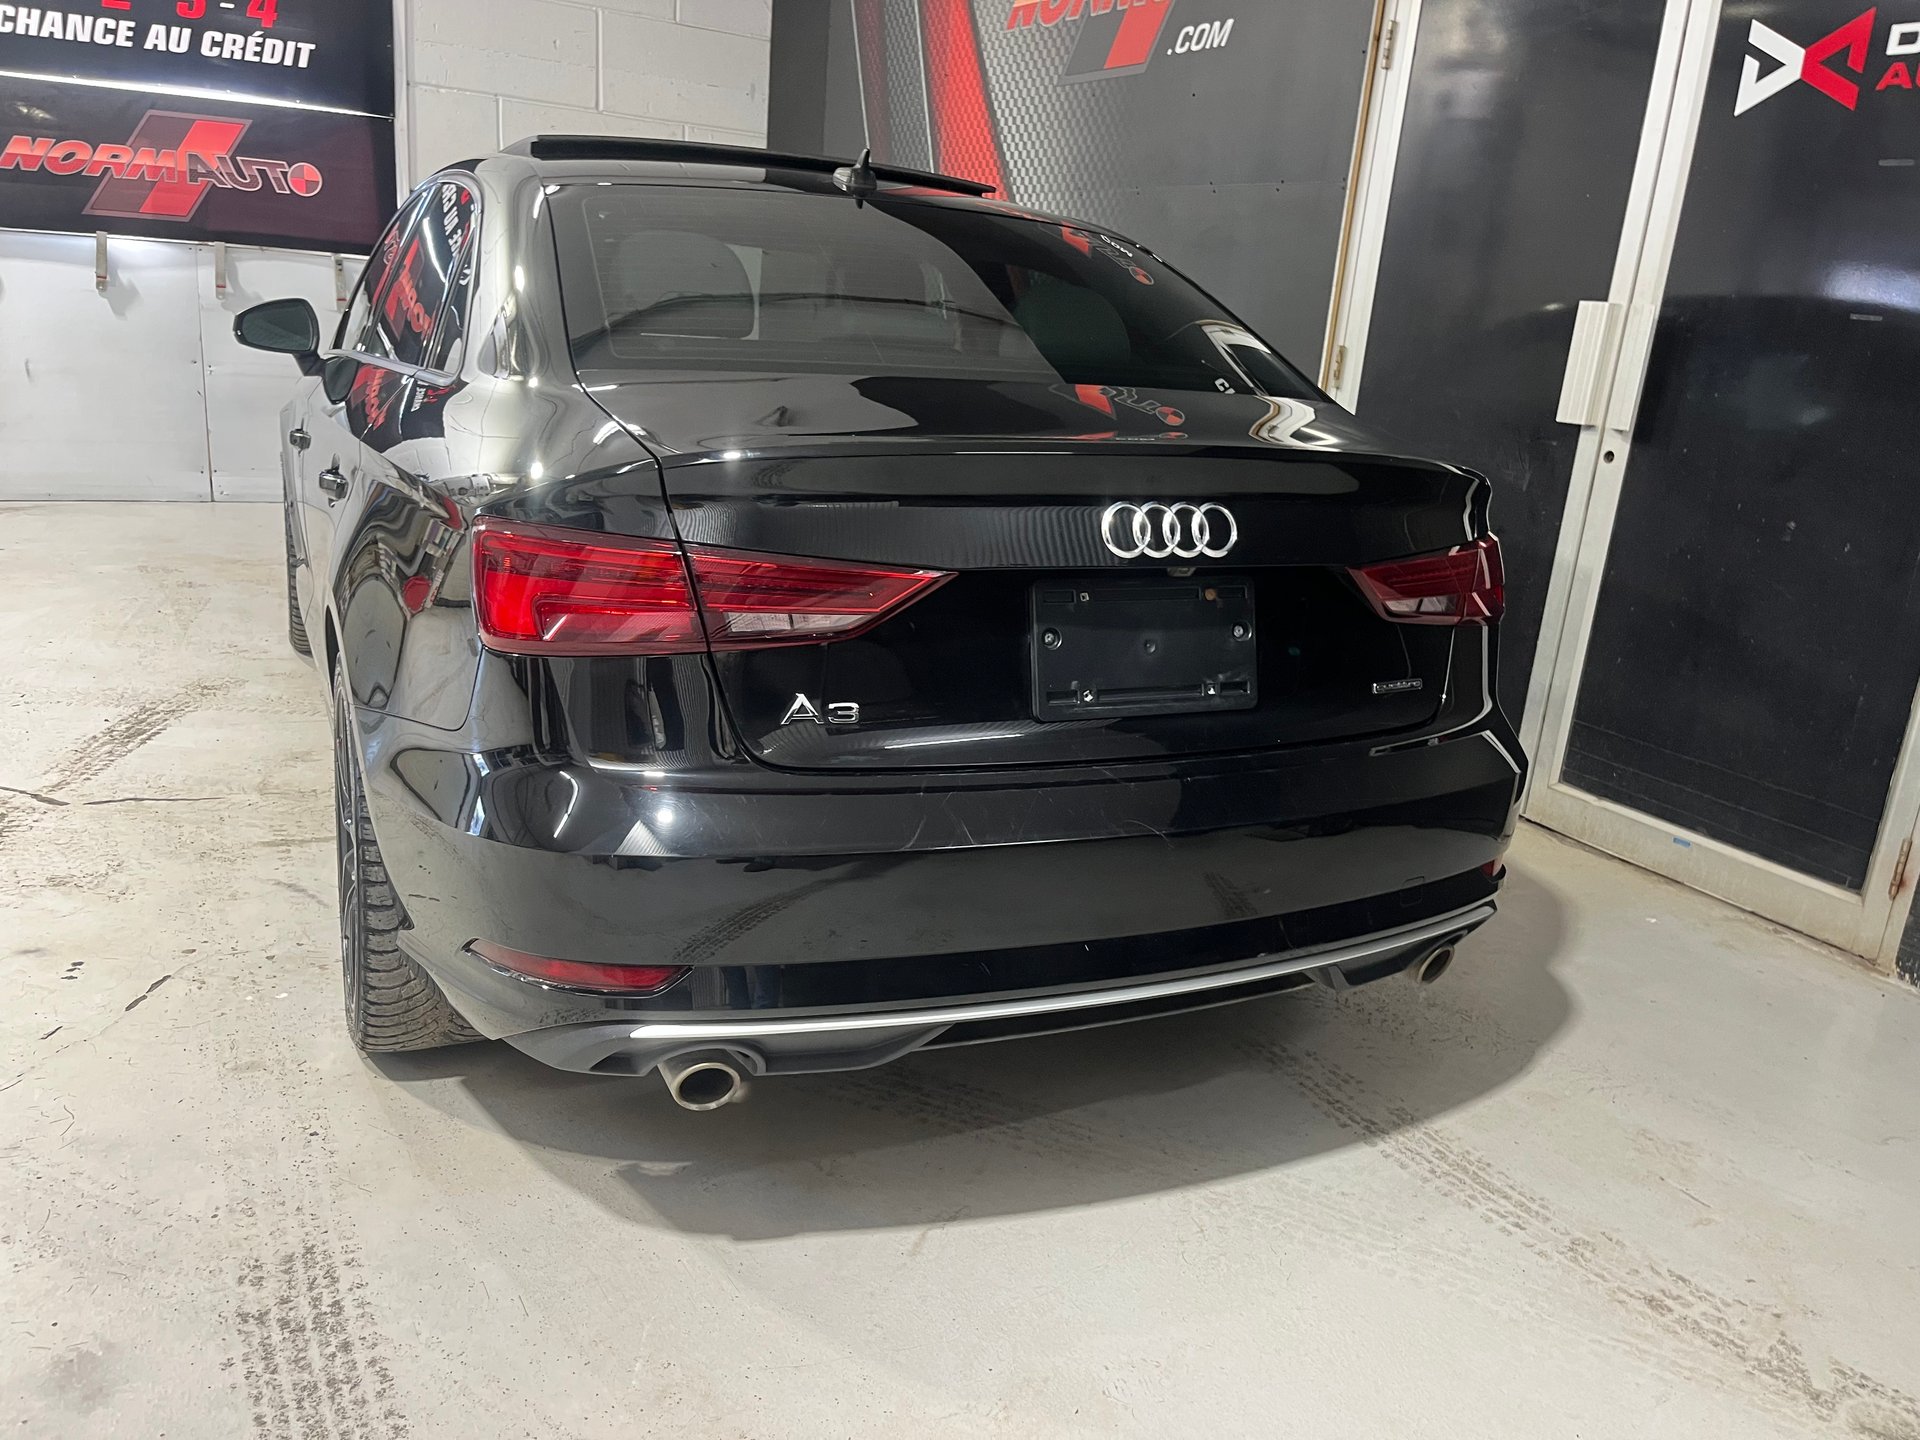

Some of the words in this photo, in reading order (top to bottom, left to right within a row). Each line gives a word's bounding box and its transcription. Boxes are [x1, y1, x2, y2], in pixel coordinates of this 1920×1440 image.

[0, 4, 136, 47] CHANCE
[143, 24, 192, 53] AU
[200, 31, 316, 68] CRÉDIT
[1875, 62, 1920, 90] A
[781, 692, 860, 725] A3
